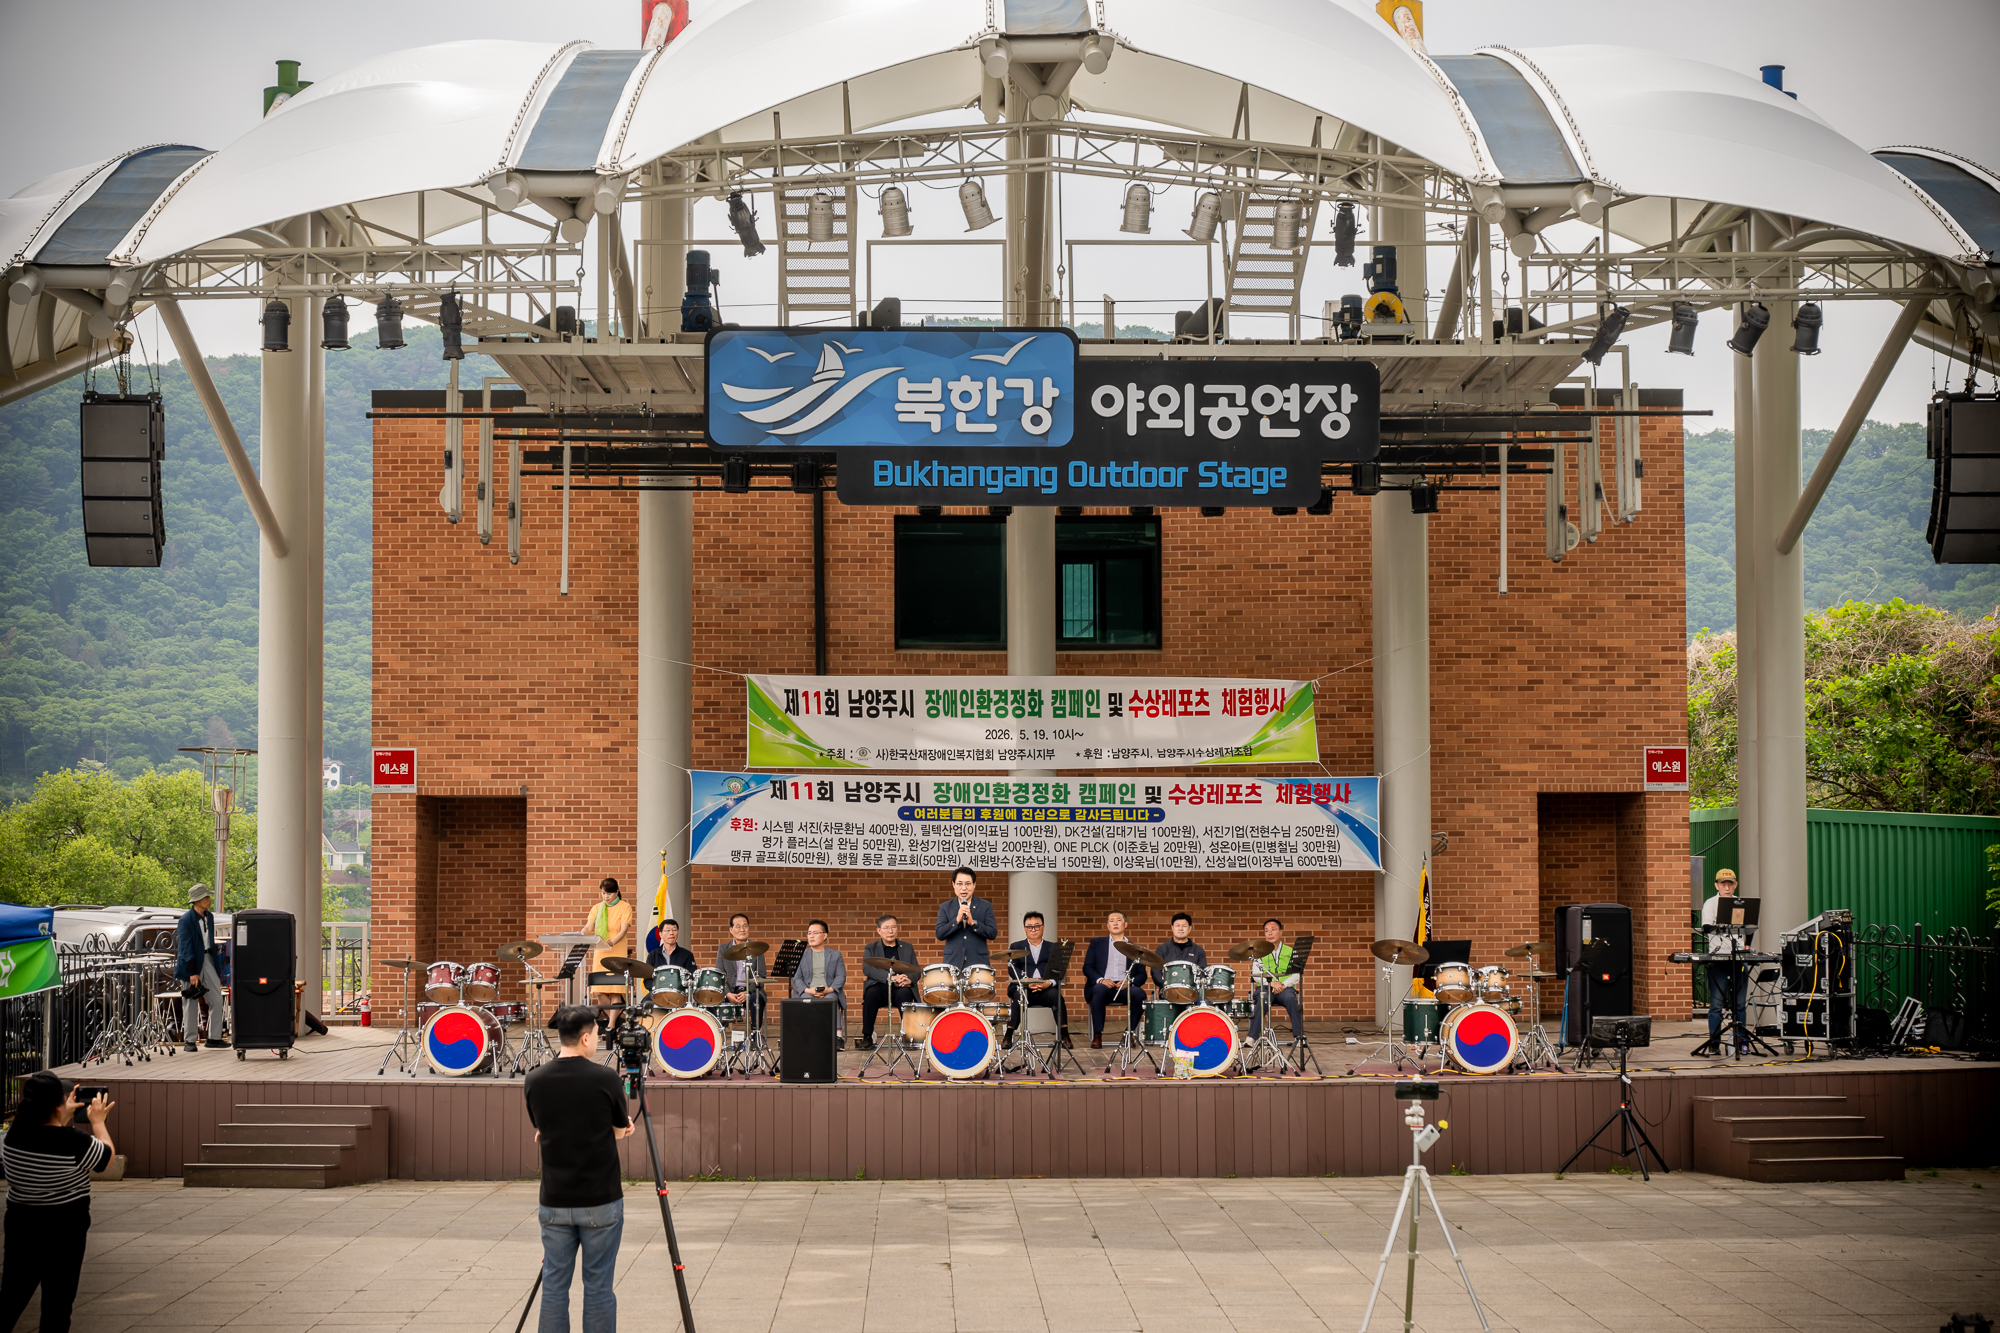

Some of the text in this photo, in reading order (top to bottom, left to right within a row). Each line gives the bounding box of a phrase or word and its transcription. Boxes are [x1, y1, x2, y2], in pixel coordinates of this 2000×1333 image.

[894, 375, 1358, 440] 북한강 야외공연장
[873, 459, 1287, 494] Bukhangang Outdoor Stage
[784, 687, 1286, 718] 제11회 남양주시 장애인환경정화 캠페인 및 수상레포츠 체험행사
[985, 728, 1084, 740] 2026. 5. 19. 10시~
[826, 748, 846, 760] 주최
[876, 748, 994, 761] 사)한국산재장애인복지협회
[997, 748, 1055, 761] 남양주시지부
[1083, 748, 1103, 760] 후원
[1156, 745, 1253, 759] 남양주시수상레저조합
[380, 763, 409, 775] 에스원
[1652, 761, 1681, 773] 에스원
[770, 780, 834, 802] 제11회
[844, 781, 920, 803] 남양주시
[933, 782, 1070, 804] 장애인환경정화
[1079, 783, 1135, 805] 캠페인
[1144, 785, 1162, 804] 및
[1168, 783, 1263, 806] 수상레포츠
[1276, 782, 1352, 805] 체험행사
[914, 808, 975, 820] 여러분들의
[980, 808, 1017, 820] 후원에
[1021, 808, 1070, 821] 진심으로
[1075, 808, 1149, 821] 감사드립니다
[730, 817, 758, 832] 후원:
[762, 820, 793, 834] 시스템
[869, 823, 917, 837] 400만원),
[1014, 824, 1061, 838] 100만원),
[1151, 825, 1199, 839] 100만원),
[1295, 824, 1340, 838] 250만원)
[762, 836, 783, 849] 명가
[862, 838, 904, 852] 50만원),
[1002, 840, 1050, 854] 200만원),
[1054, 841, 1077, 853] ONE
[1081, 841, 1109, 853] PLCK
[1163, 840, 1205, 854] 20만원),
[1302, 839, 1341, 854] 30만원)
[731, 850, 752, 863] 땡큐
[755, 850, 833, 865] 골프회(50만원),
[862, 853, 883, 866] 동문
[1062, 855, 1109, 869] 150만원),
[1297, 855, 1342, 869] 600만원)
